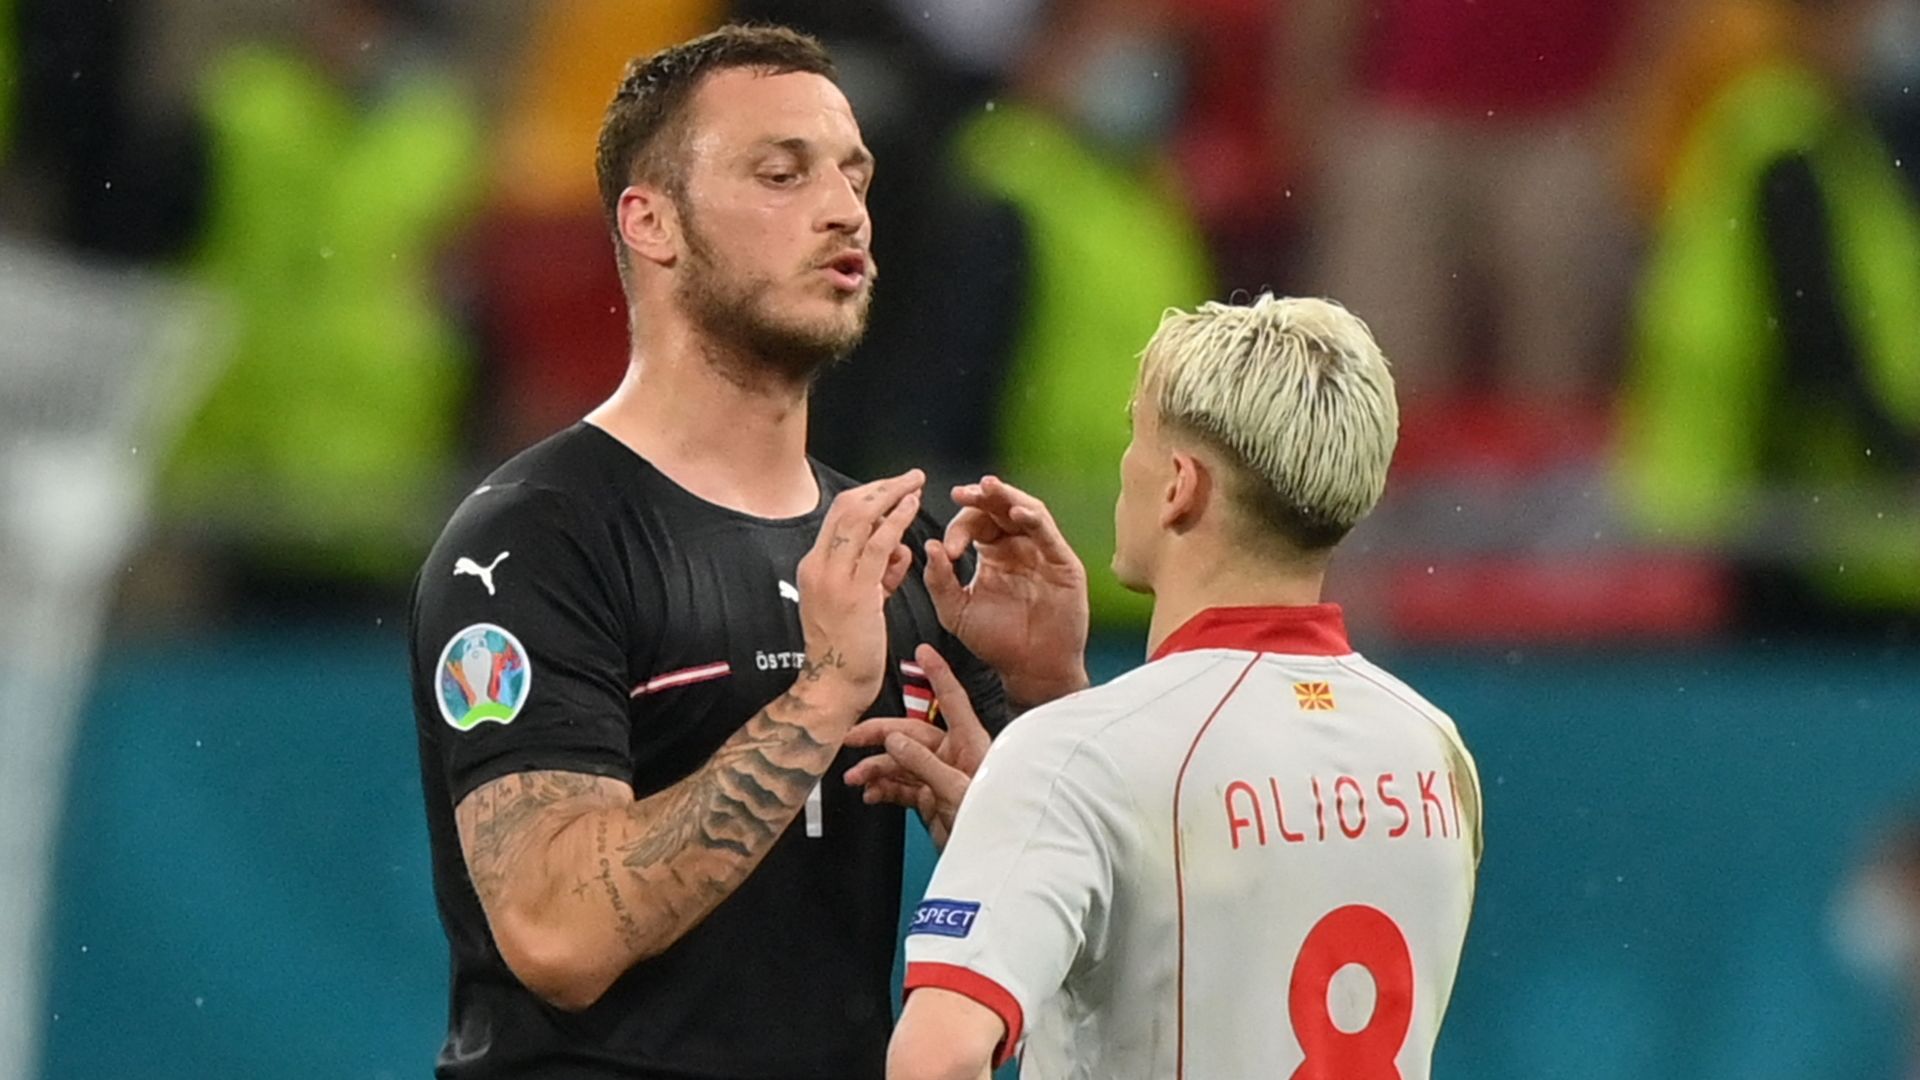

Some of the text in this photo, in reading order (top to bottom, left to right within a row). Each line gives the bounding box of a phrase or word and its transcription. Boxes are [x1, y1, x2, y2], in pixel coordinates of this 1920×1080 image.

[1224, 771, 1461, 849] ALIOSKI
[911, 907, 975, 927] SPECT
[1288, 904, 1414, 1080] 8
